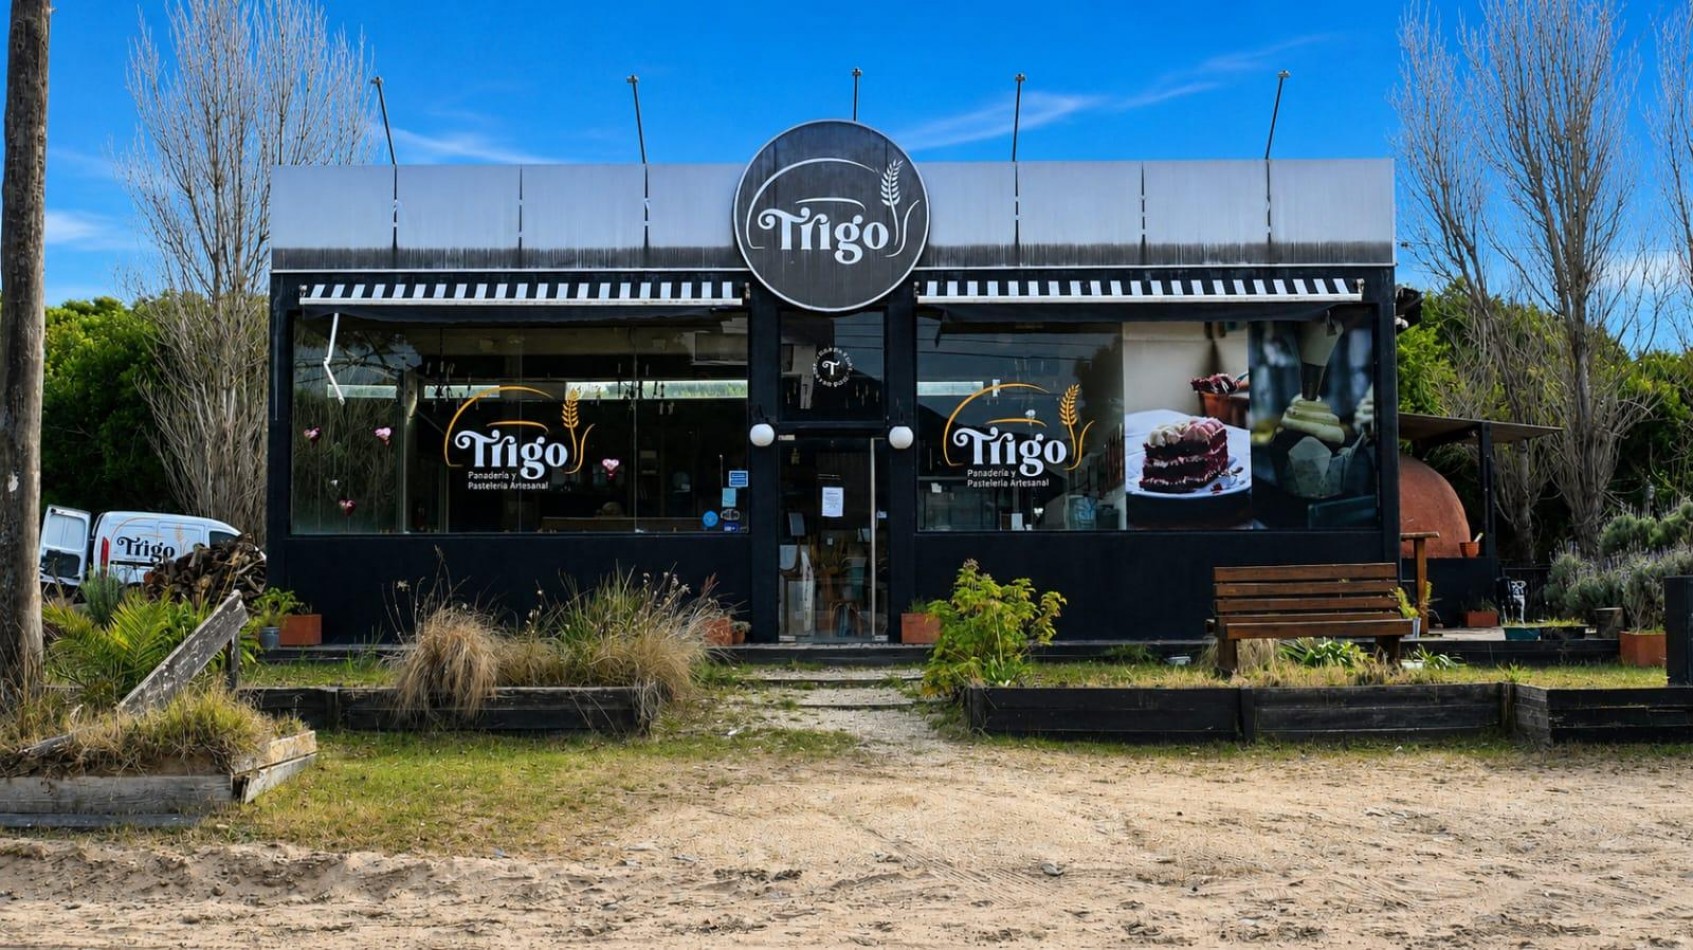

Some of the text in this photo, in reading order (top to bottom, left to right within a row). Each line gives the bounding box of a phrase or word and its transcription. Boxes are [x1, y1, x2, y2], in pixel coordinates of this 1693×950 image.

[757, 207, 889, 265] Trigo
[454, 429, 568, 480] Trigo
[952, 426, 1067, 477] Trigo
[511, 473, 517, 481] y
[1010, 470, 1016, 478] y
[1010, 478, 1050, 488] Artesanal
[509, 481, 549, 490] Artesanal
[116, 536, 175, 563] Trigo
